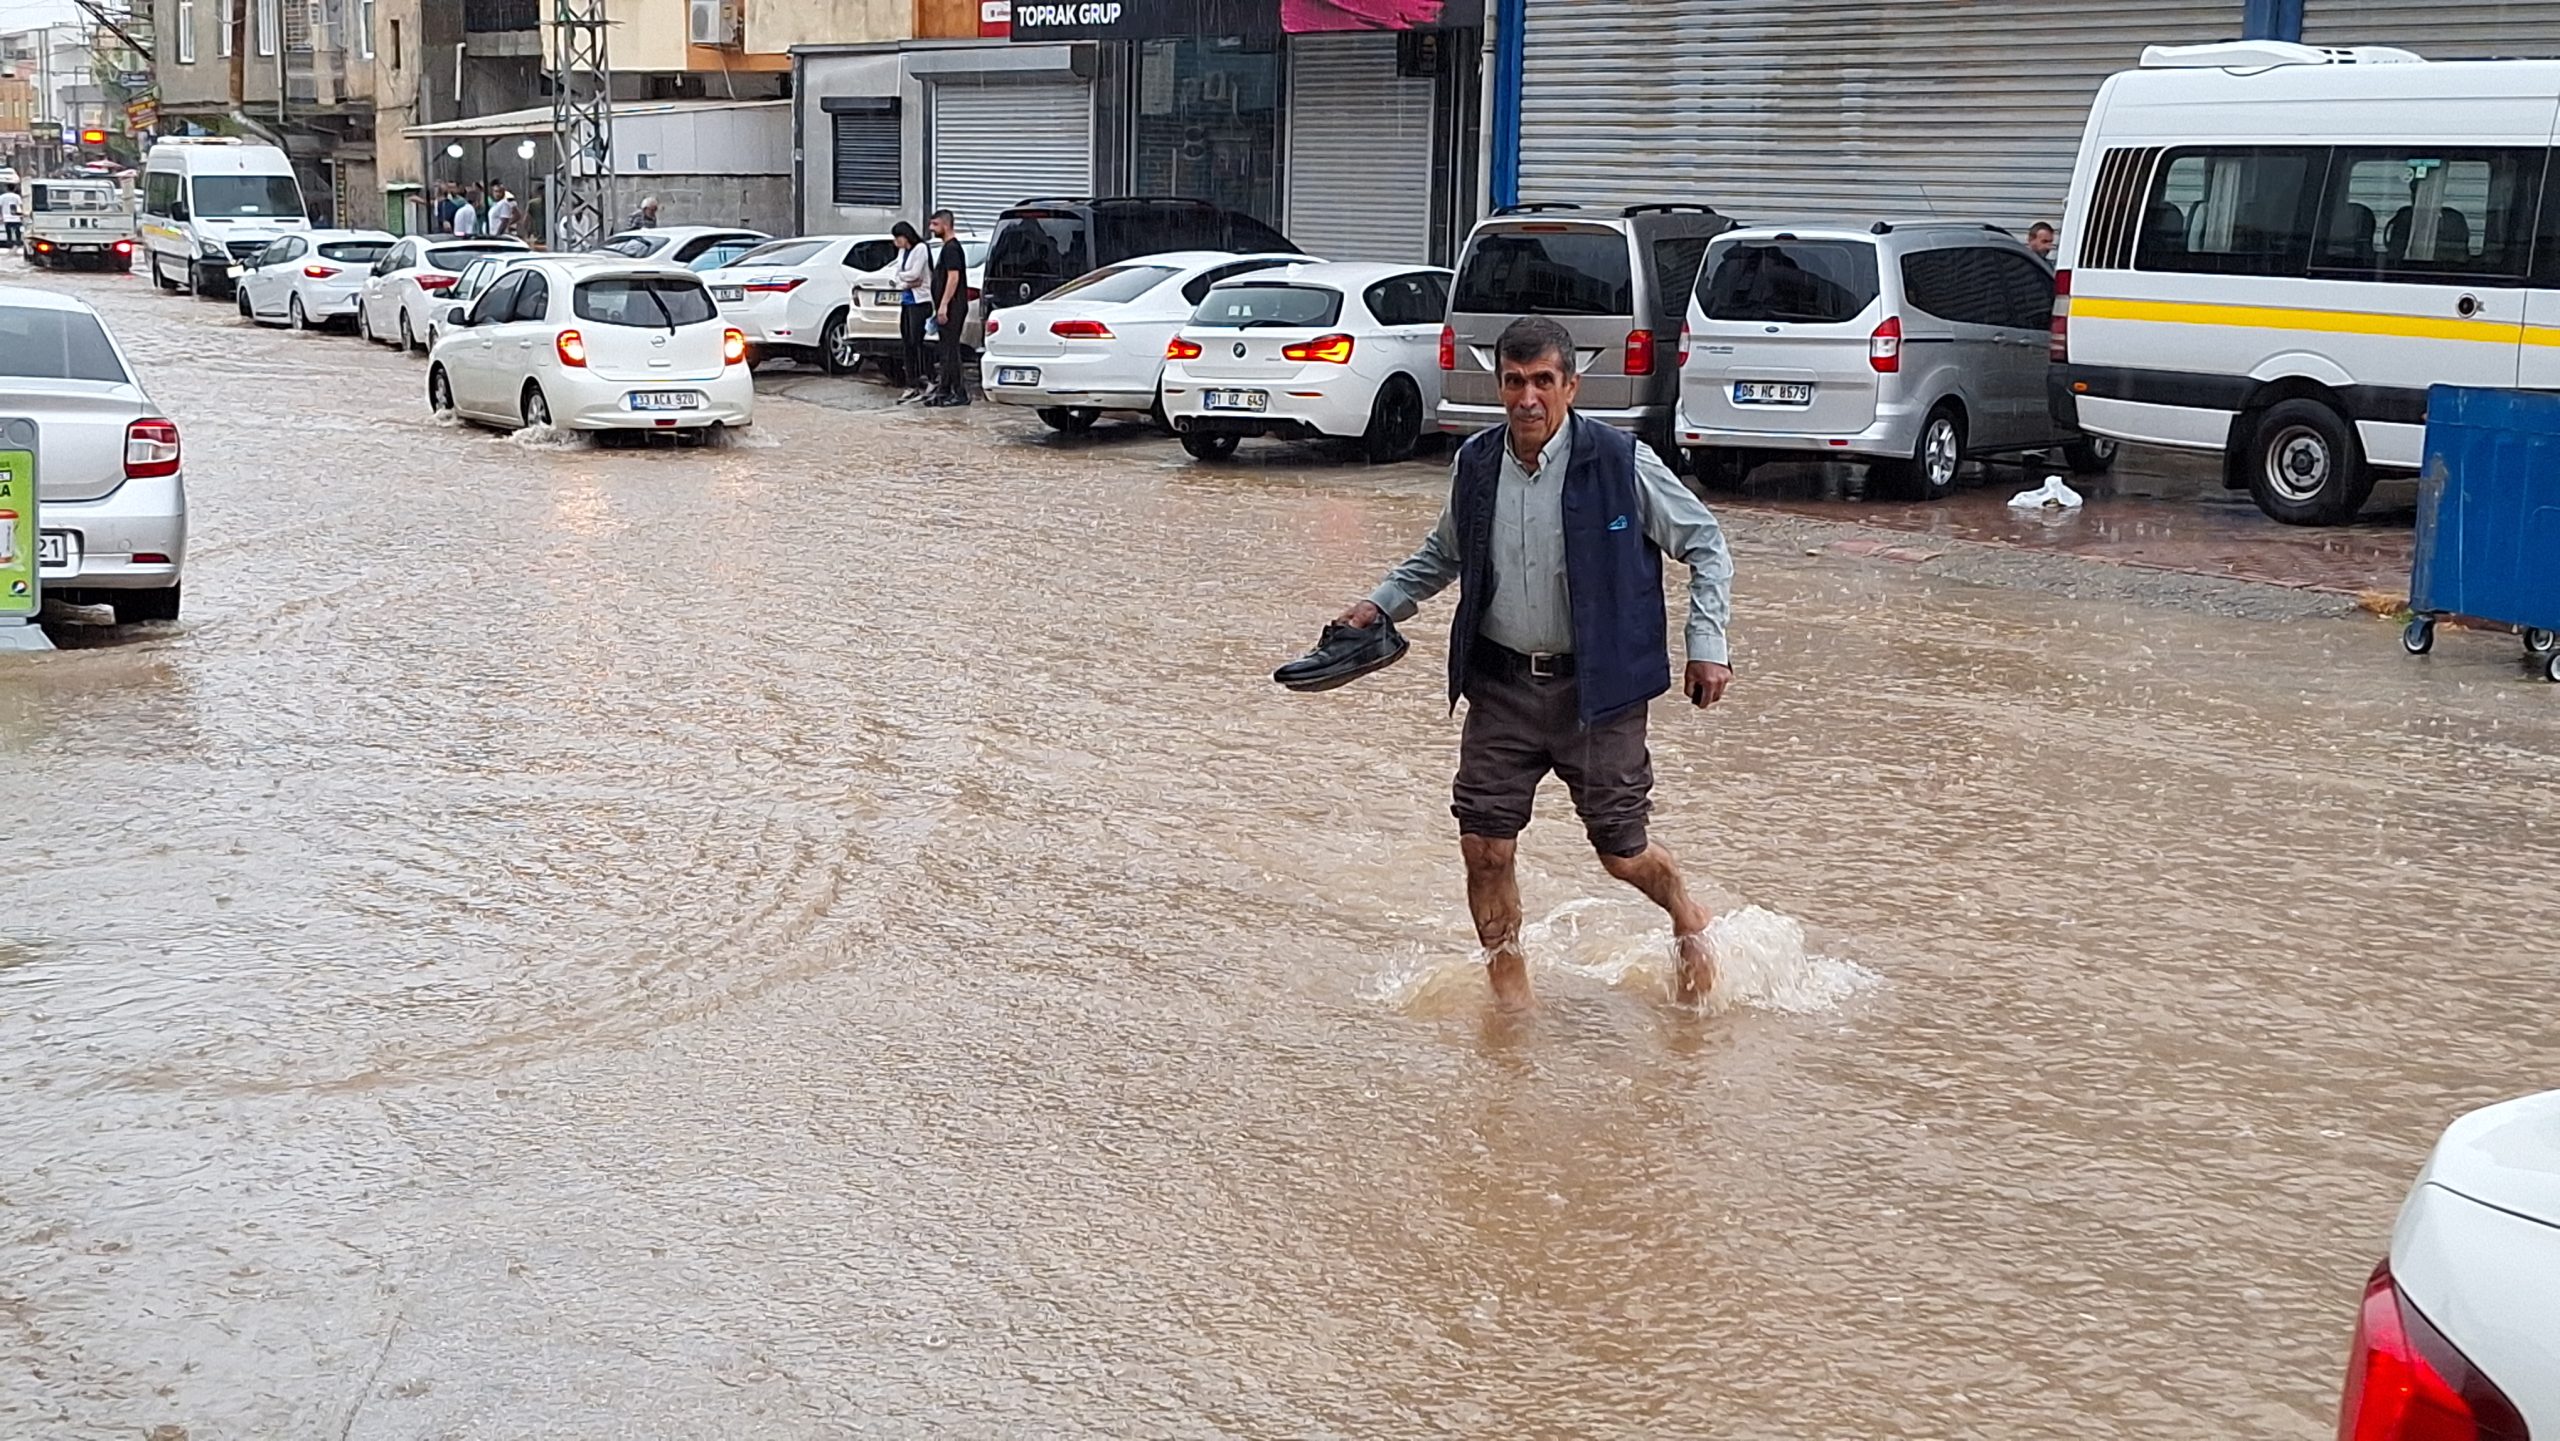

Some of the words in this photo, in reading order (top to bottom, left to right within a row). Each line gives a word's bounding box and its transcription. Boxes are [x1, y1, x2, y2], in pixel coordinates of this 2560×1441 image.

[1017, 4, 1077, 27] TOPRAK
[1079, 3, 1121, 25] GRUP
[69, 217, 99, 229] BMC
[1742, 384, 1754, 397] 06
[654, 394, 672, 405] ACA
